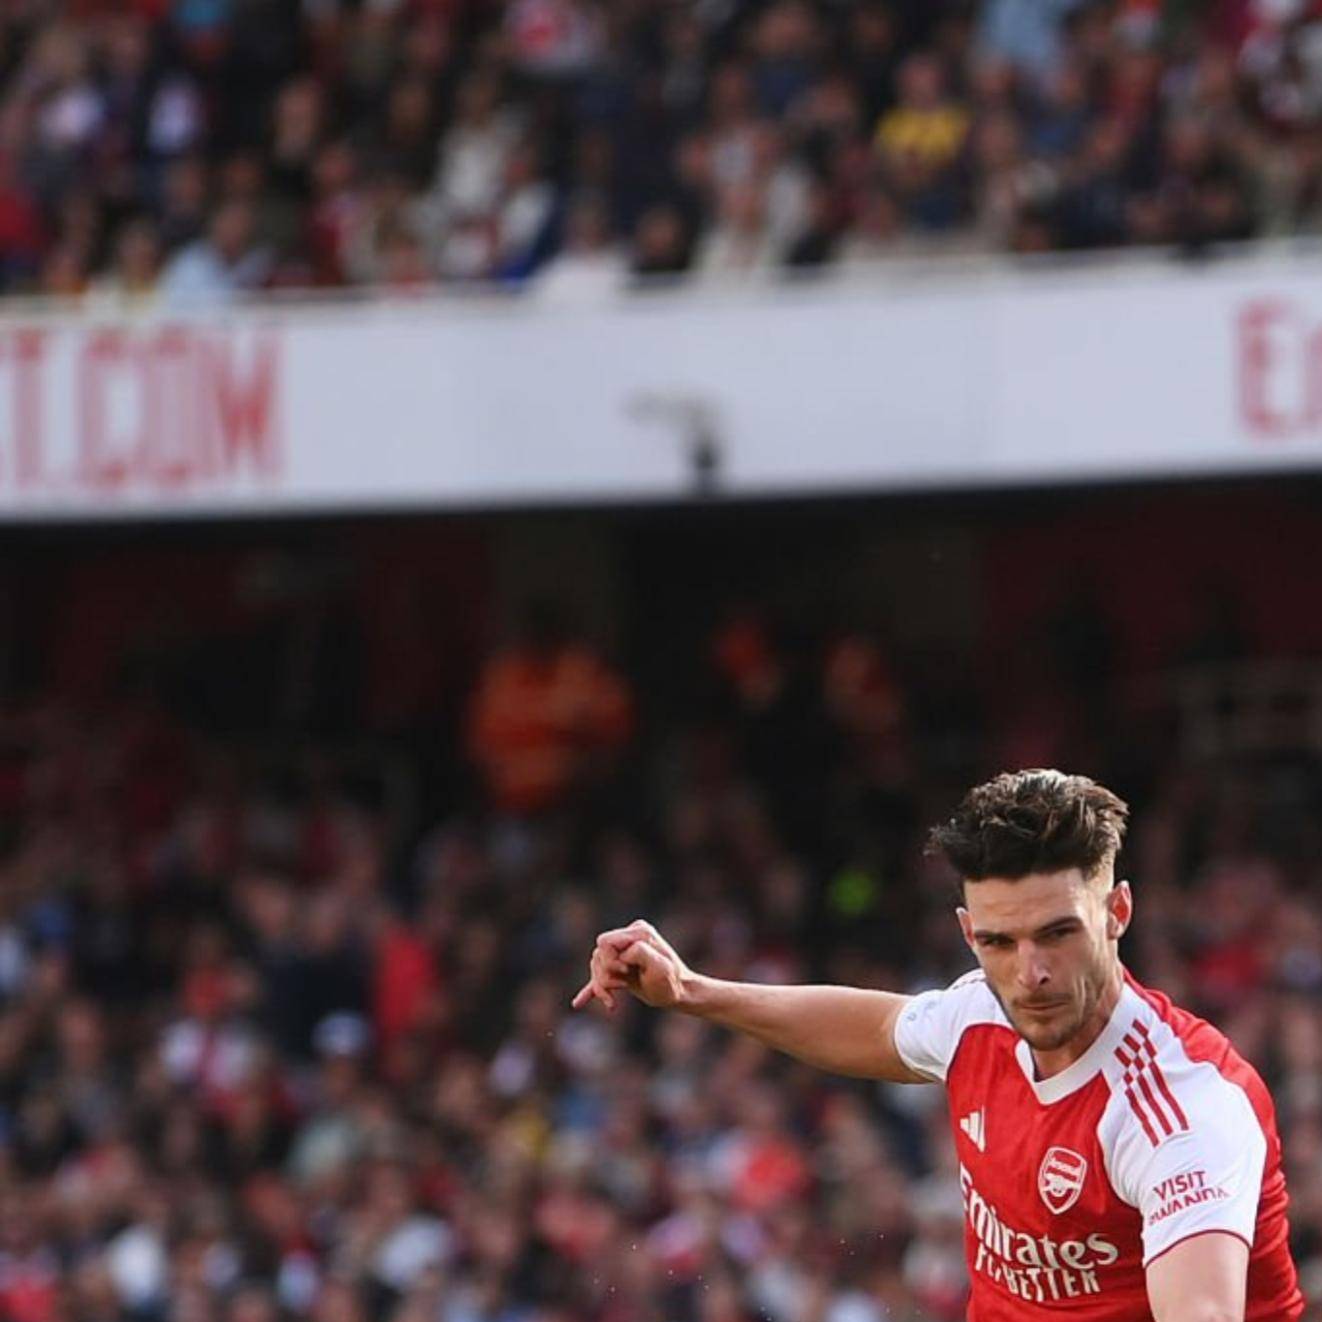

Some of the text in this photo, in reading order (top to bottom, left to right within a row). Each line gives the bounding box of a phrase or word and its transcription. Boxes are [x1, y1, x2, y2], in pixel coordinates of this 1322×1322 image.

[0, 322, 281, 494] T.COM
[960, 1161, 1119, 1270] Emirates
[1152, 1170, 1206, 1201] VISIT
